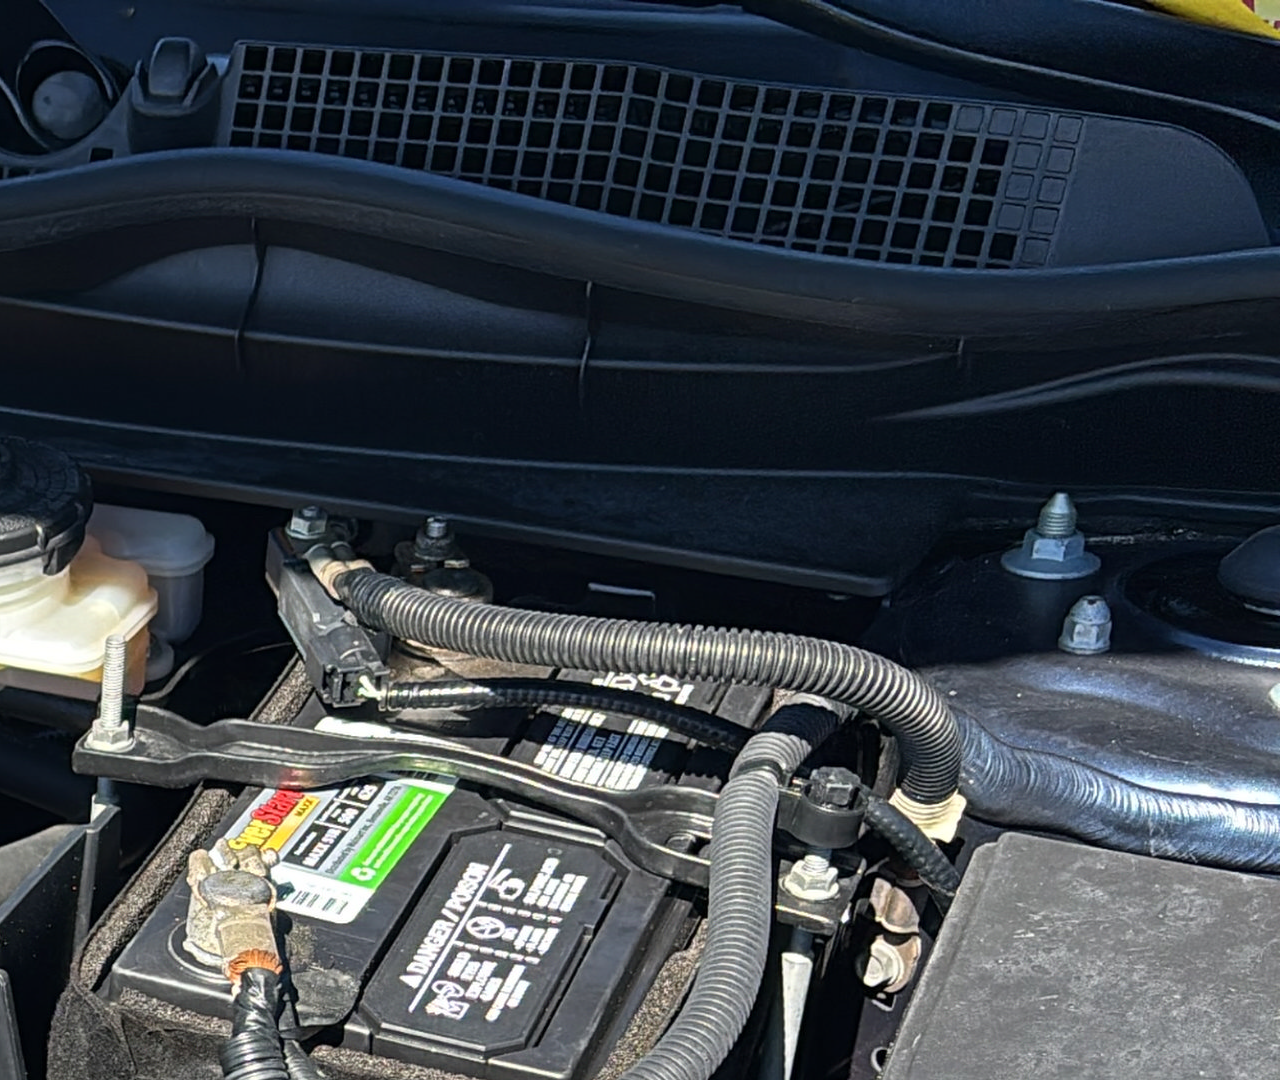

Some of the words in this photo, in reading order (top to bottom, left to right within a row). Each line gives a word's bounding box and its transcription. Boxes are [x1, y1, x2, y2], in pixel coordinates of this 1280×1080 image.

[294, 797, 315, 818] MAXX
[406, 919, 456, 976] DANGER
[444, 862, 490, 912] POISON
